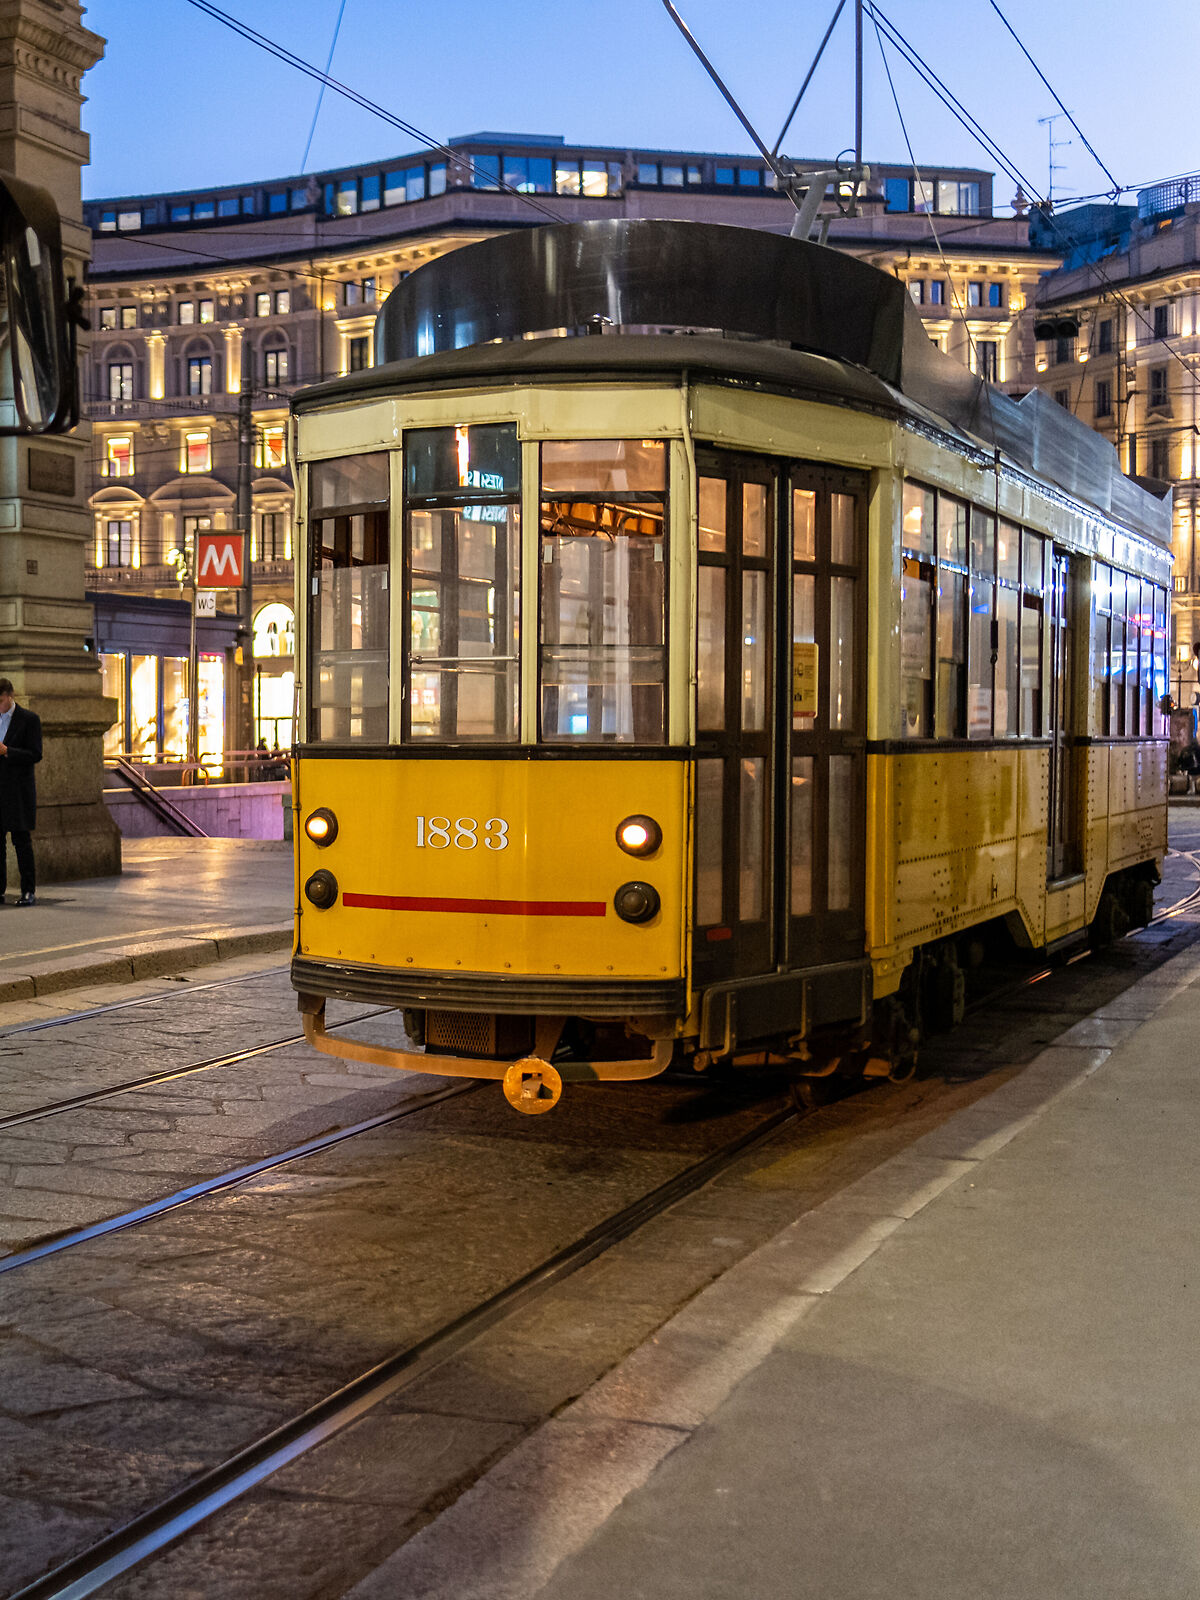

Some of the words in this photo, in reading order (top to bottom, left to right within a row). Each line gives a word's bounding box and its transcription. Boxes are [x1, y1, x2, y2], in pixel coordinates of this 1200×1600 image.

[200, 544, 239, 576] M
[198, 599, 214, 609] WC
[416, 816, 509, 850] 1883
